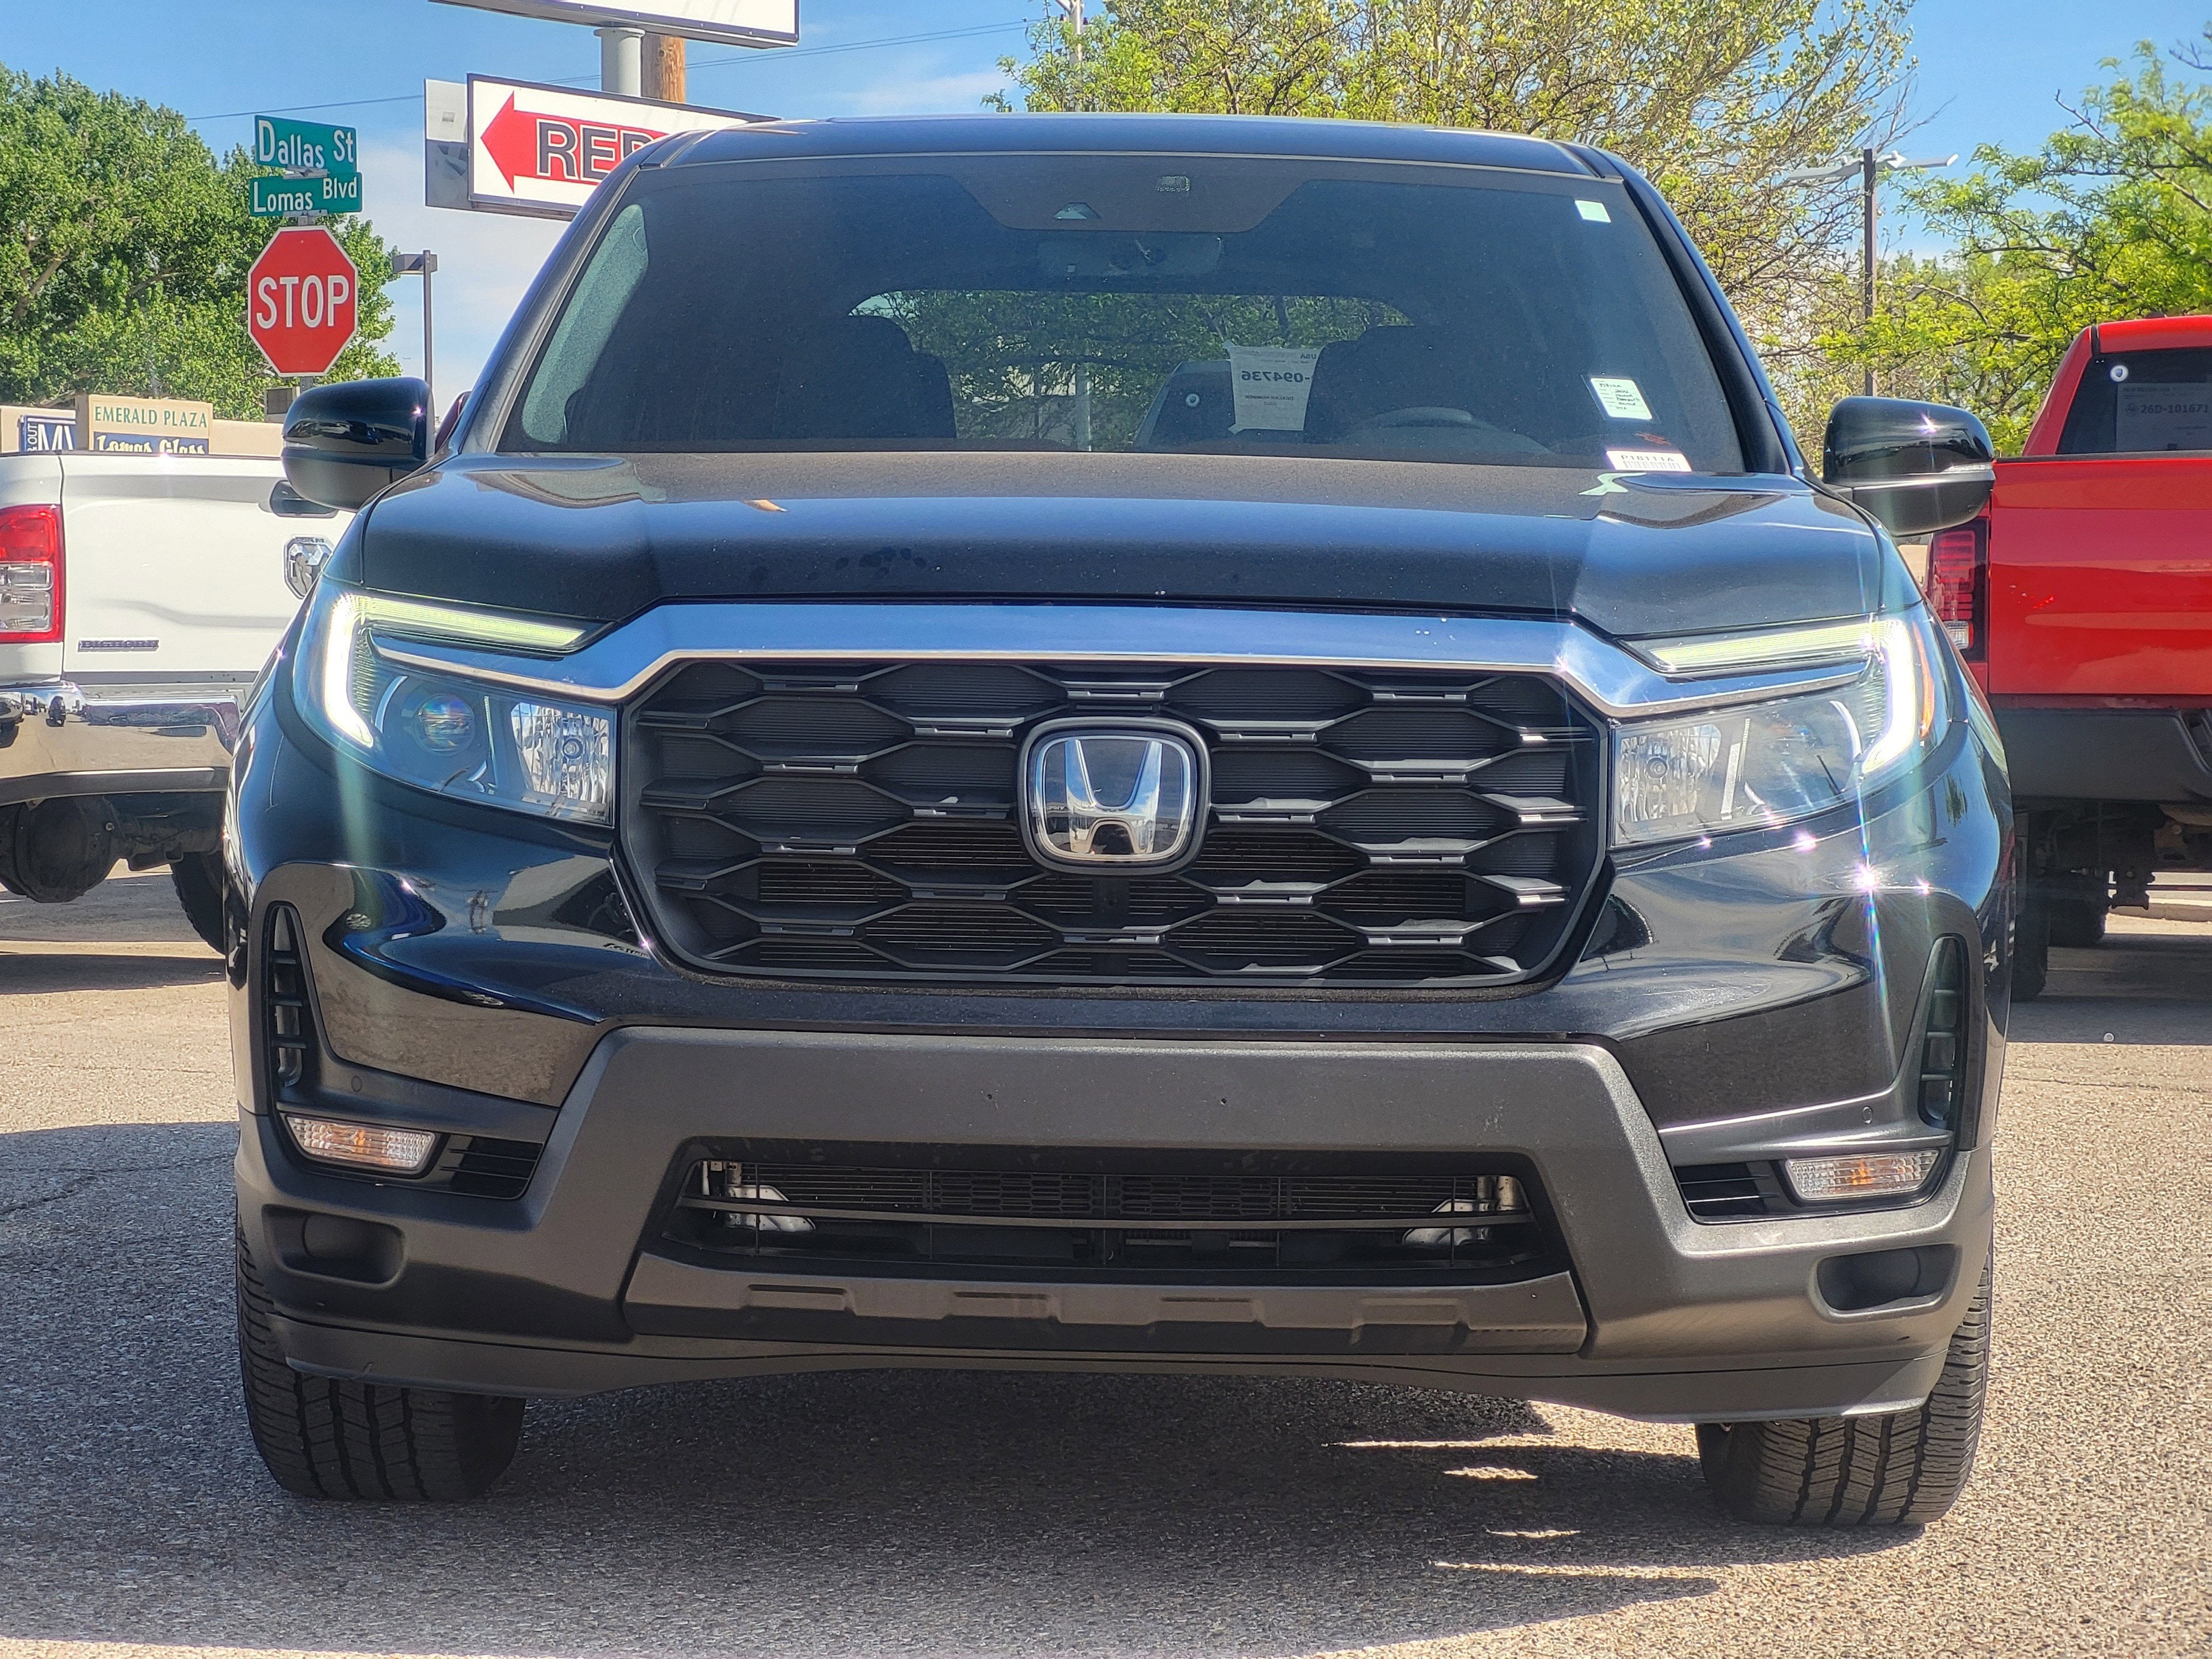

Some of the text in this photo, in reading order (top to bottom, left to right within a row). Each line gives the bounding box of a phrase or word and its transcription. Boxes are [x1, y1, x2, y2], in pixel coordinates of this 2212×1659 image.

[258, 119, 354, 168] Dallas St
[253, 176, 357, 213] Lomas Blvd
[257, 275, 349, 329] STOP
[27, 423, 38, 445] OUT
[95, 406, 207, 428] EMERALD PLAZA
